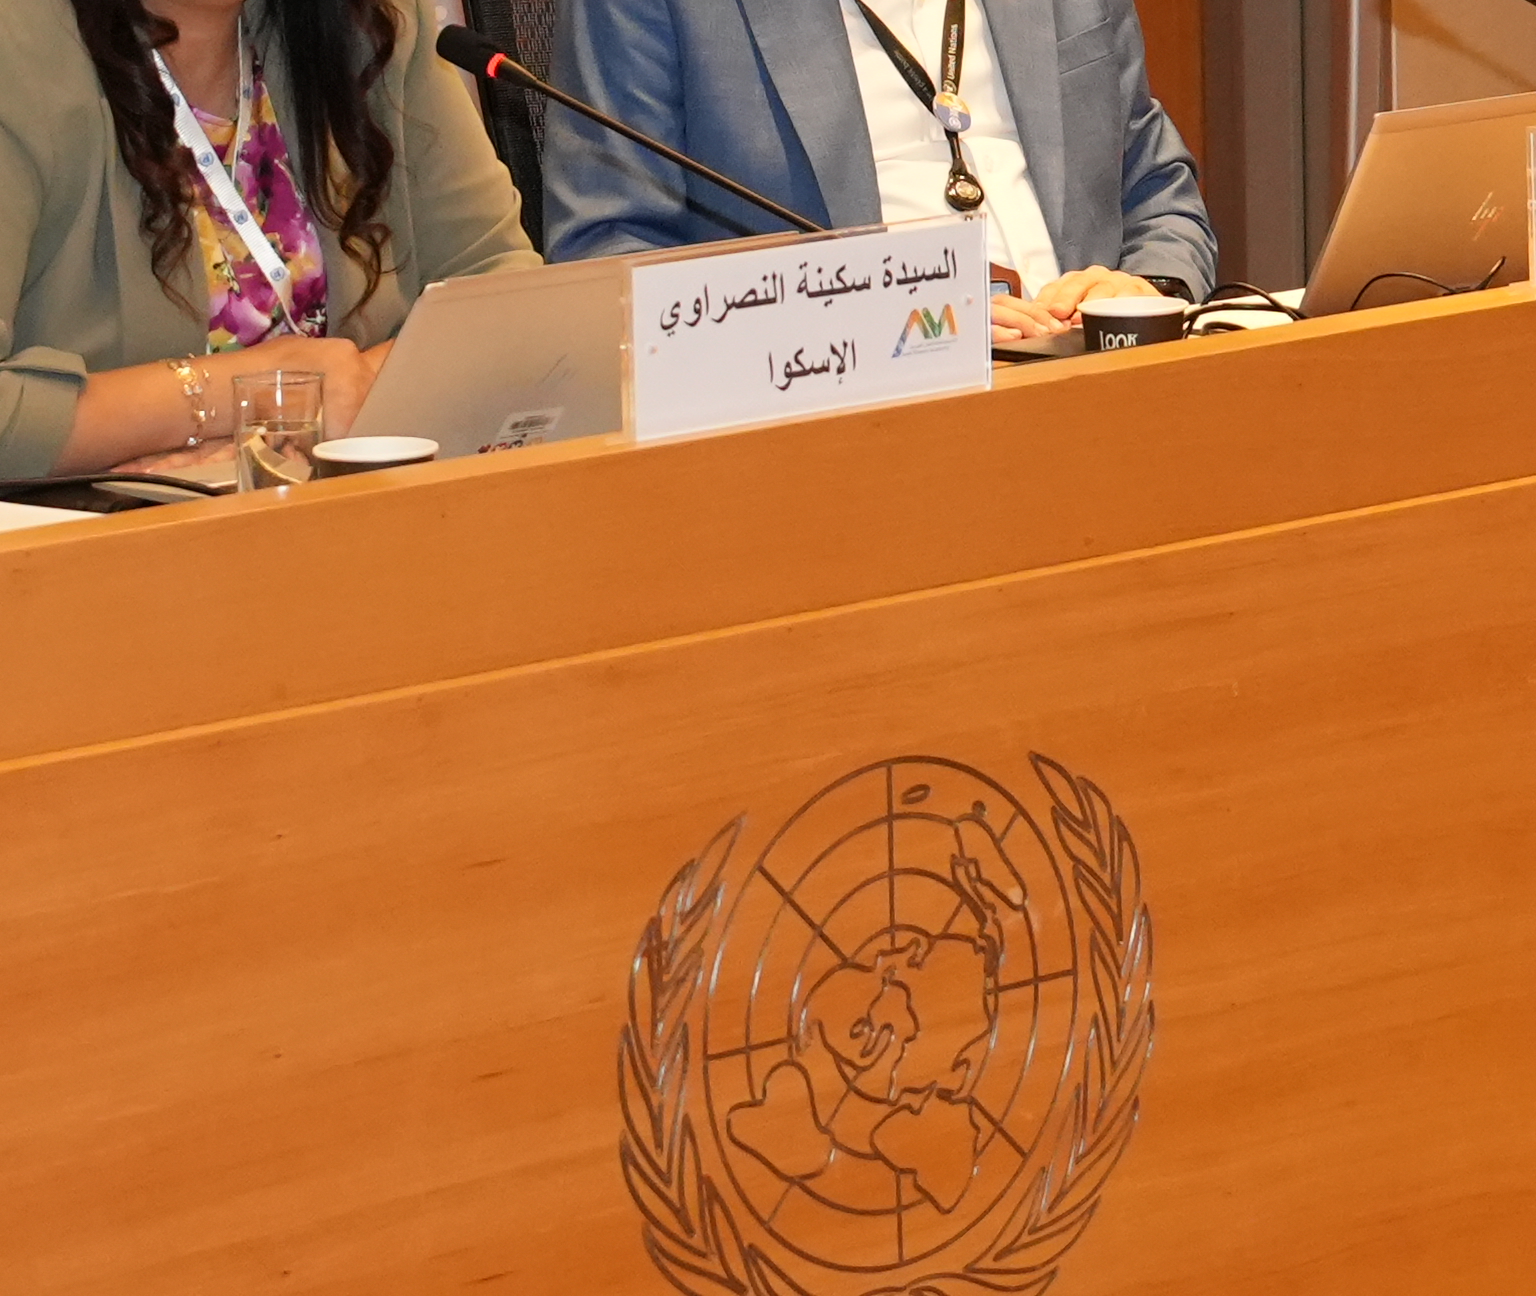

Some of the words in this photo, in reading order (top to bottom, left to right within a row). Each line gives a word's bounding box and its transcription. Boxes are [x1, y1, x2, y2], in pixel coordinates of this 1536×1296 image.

[796, 265, 873, 308] سكينة
[881, 248, 958, 299] السيدة
[659, 274, 784, 333] النصراوي
[768, 339, 858, 394] الإسكوا
